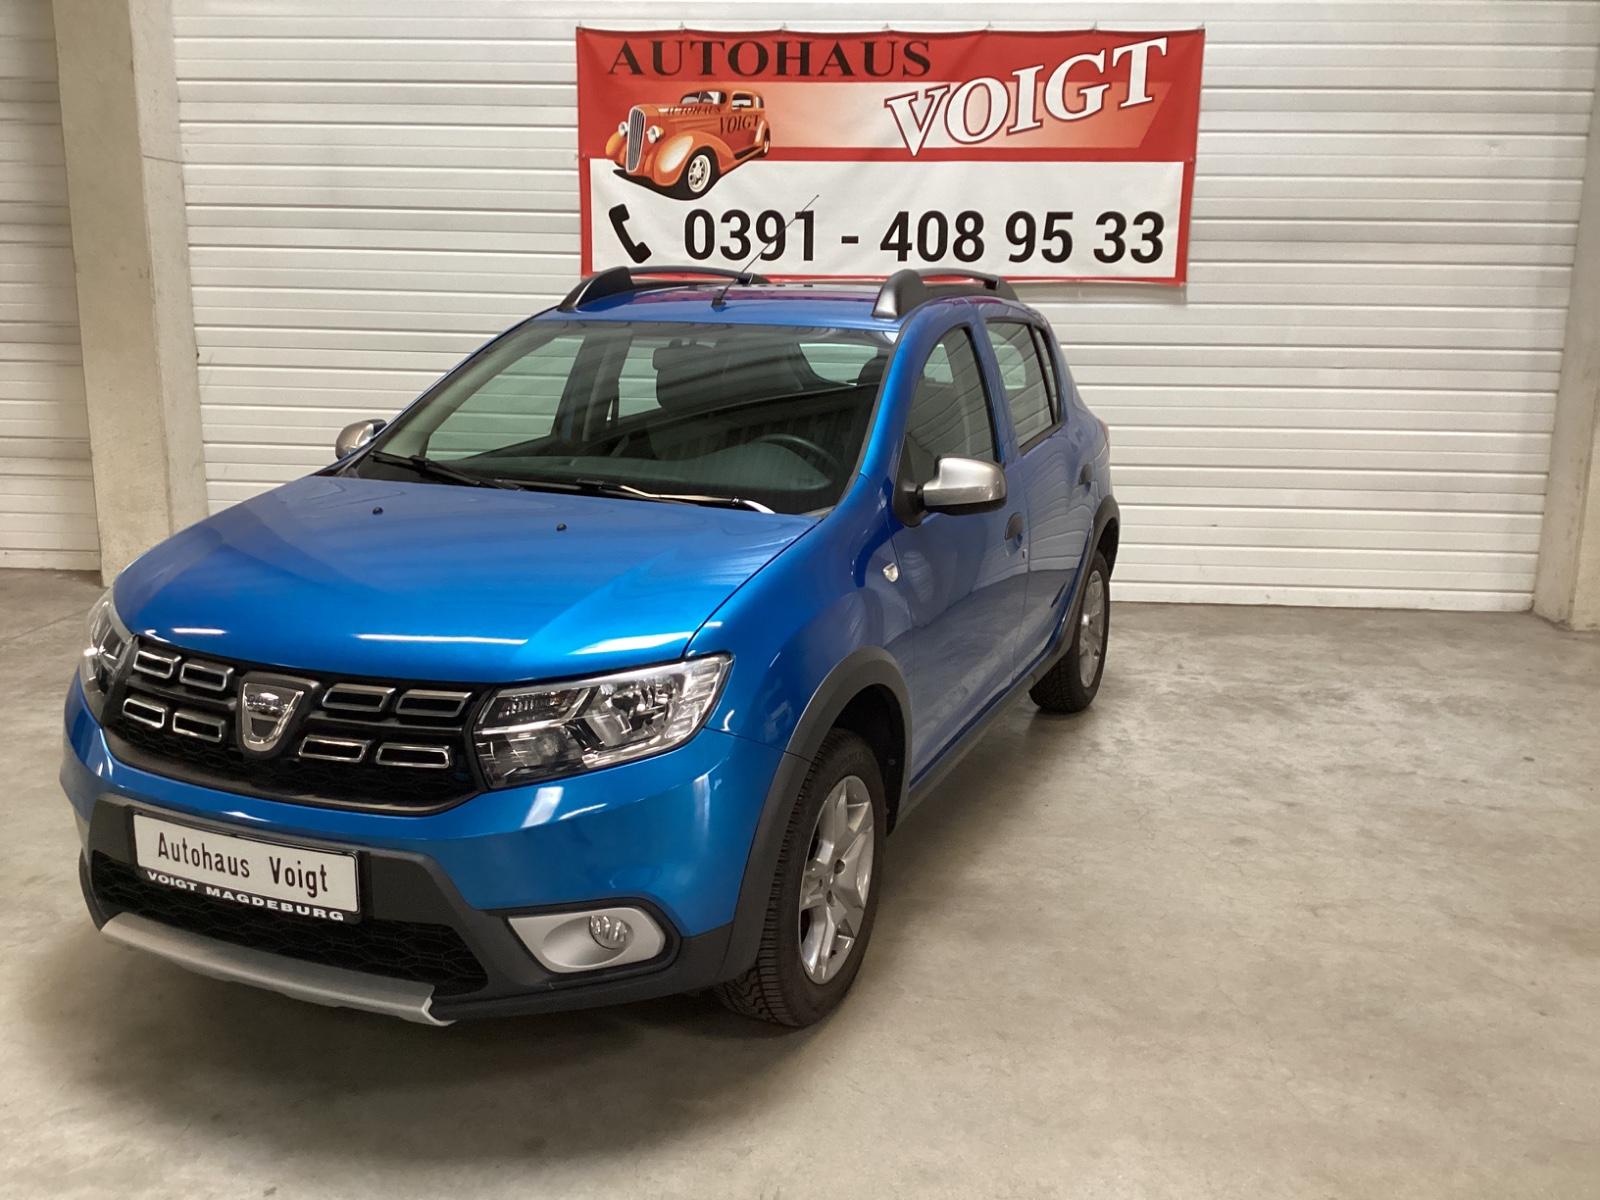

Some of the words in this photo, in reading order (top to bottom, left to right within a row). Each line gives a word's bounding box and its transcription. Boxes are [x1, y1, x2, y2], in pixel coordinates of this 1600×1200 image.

[609, 40, 930, 77] AUTOHAUS
[885, 37, 1168, 156] VOIGT
[684, 209, 815, 262] 0391
[842, 234, 859, 243] -
[880, 209, 985, 262] 408
[1005, 209, 1074, 264] 95
[1093, 211, 1164, 264] 33
[158, 833, 250, 878] Autohaus
[269, 856, 328, 898] Voigt
[146, 871, 198, 891] VOIGT
[206, 888, 344, 921] MAGDEBURG
